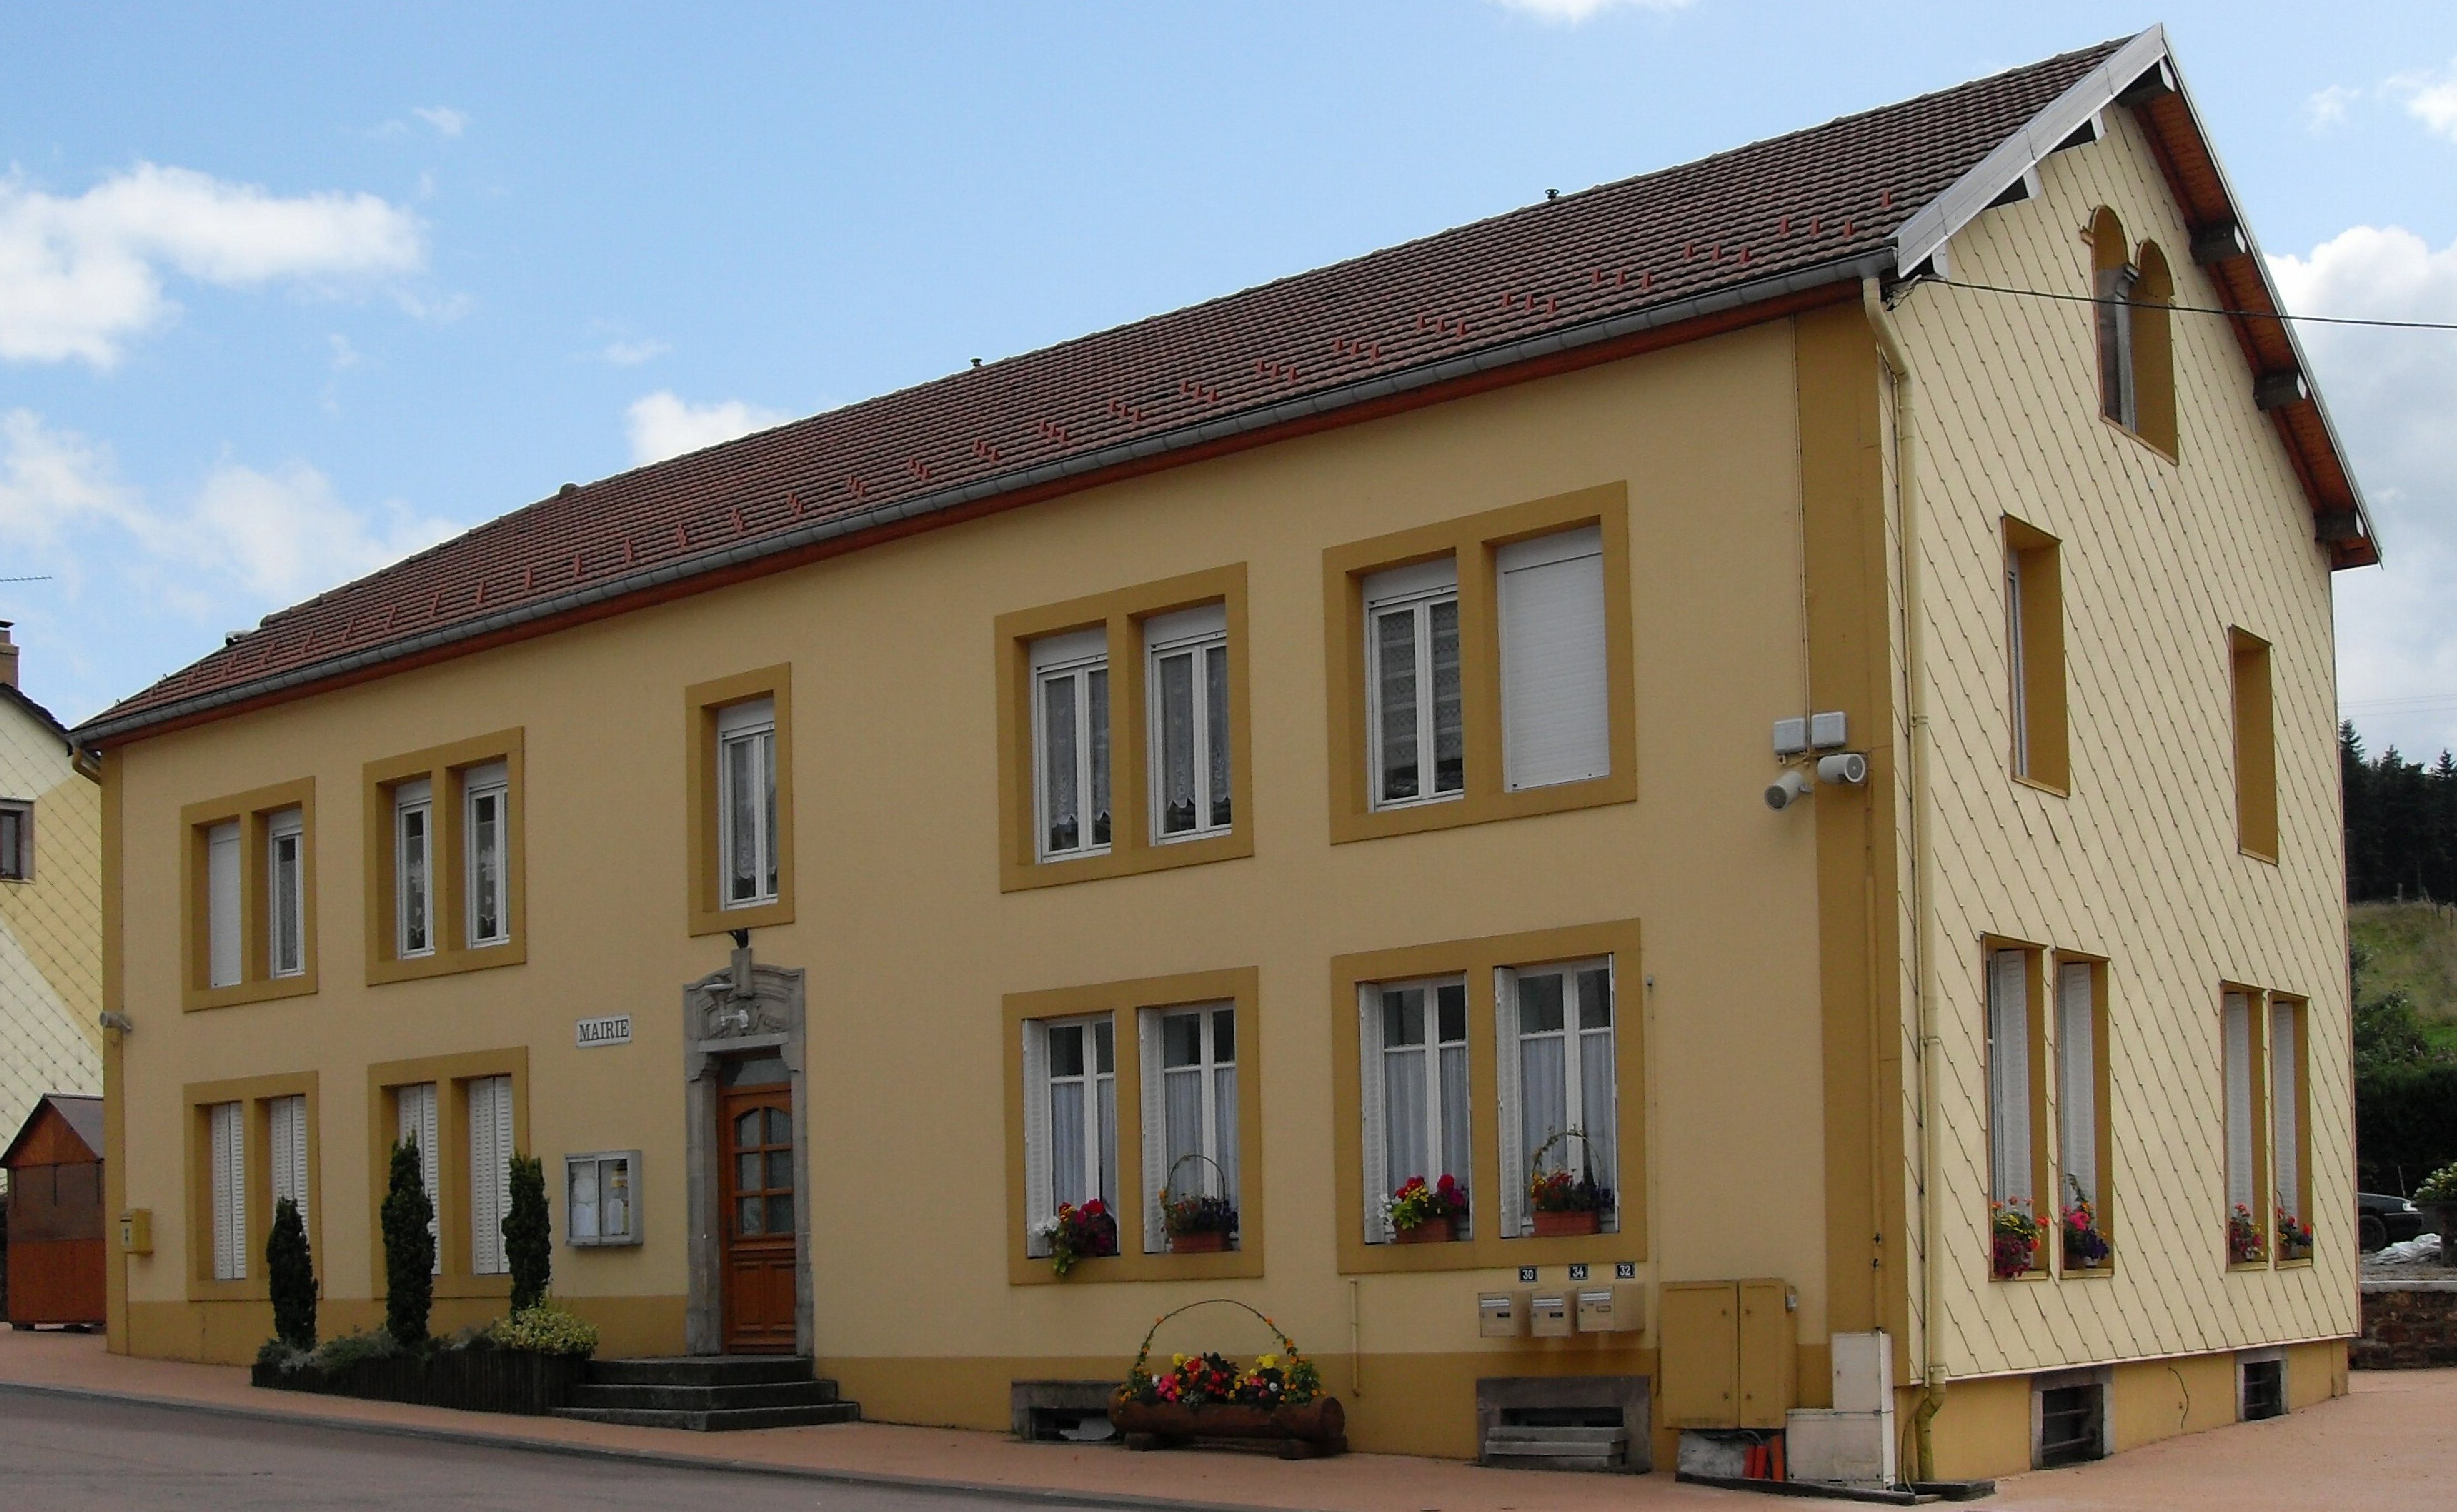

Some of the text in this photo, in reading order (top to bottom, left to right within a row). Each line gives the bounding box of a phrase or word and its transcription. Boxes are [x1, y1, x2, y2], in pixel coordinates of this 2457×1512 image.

[579, 1019, 629, 1042] MAIRIE
[1523, 1269, 1534, 1279] 30
[1573, 1267, 1584, 1277] 34
[1619, 1265, 1631, 1276] 32
